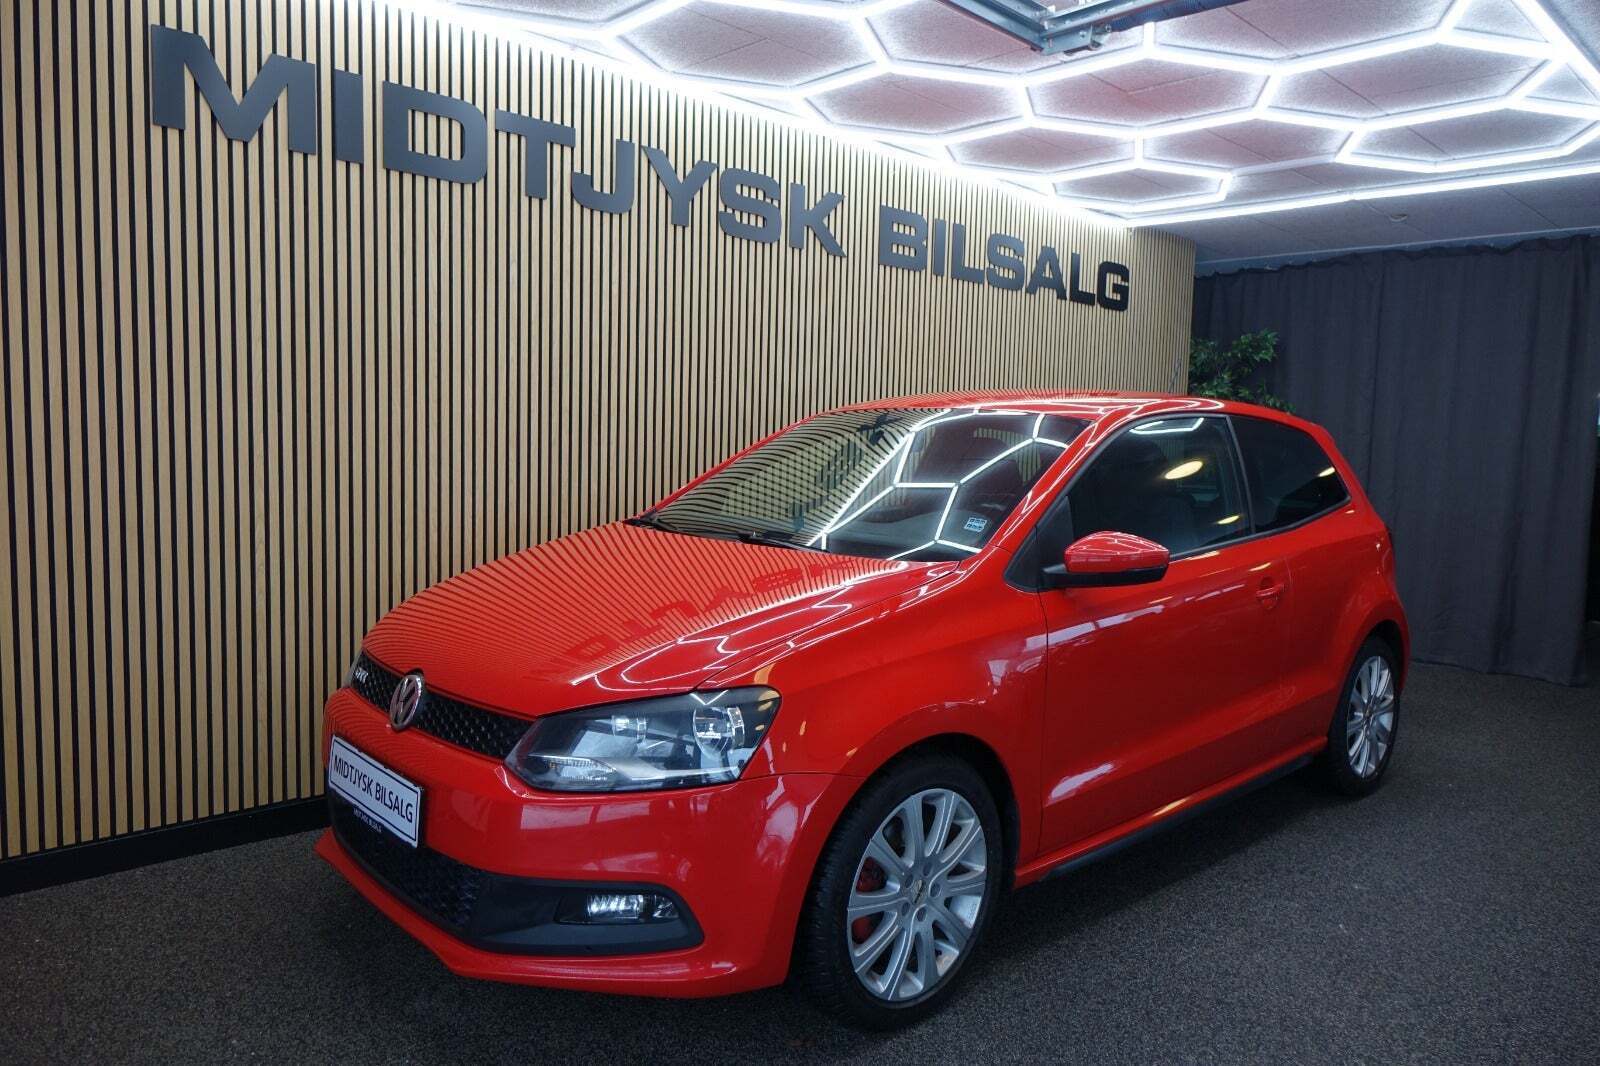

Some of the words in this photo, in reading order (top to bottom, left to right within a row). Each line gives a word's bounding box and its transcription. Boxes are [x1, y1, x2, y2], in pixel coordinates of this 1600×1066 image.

[151, 24, 847, 258] MIDTJYSK
[878, 204, 1130, 312] BILSALG
[333, 754, 373, 798] MIDTJYSK
[374, 782, 413, 823] BILSALG
